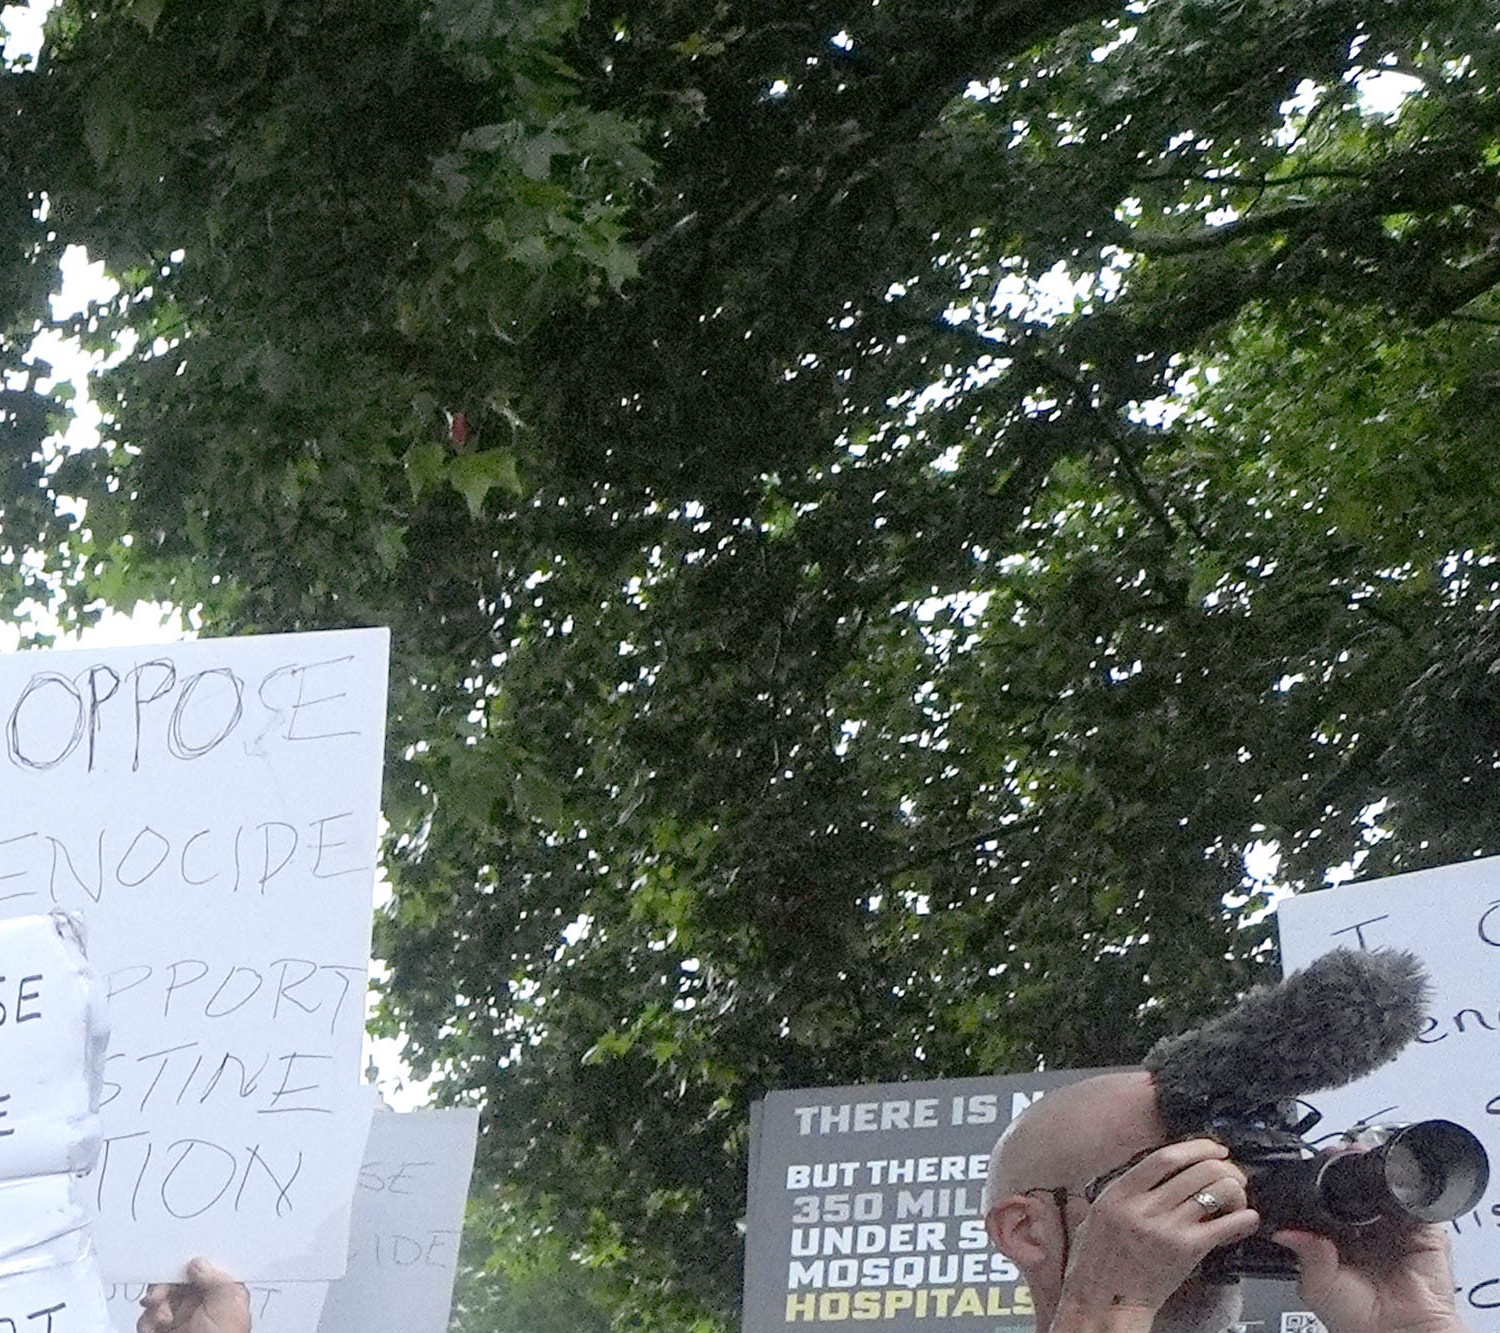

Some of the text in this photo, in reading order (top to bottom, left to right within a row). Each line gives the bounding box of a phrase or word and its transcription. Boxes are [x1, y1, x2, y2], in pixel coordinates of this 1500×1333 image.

[7, 656, 363, 772] OPPOSE
[102, 959, 371, 1032] PPORT
[100, 1043, 332, 1113] STINE
[795, 1096, 942, 1137] THERE
[950, 1094, 999, 1126] IS
[98, 1131, 301, 1221] TION
[785, 1154, 989, 1192] BUT THERE
[791, 1188, 985, 1225] 350 MIL
[791, 1223, 946, 1257] UNDER
[786, 1254, 1019, 1290] MOSQUES
[785, 1287, 1035, 1323] HOSPITALS
